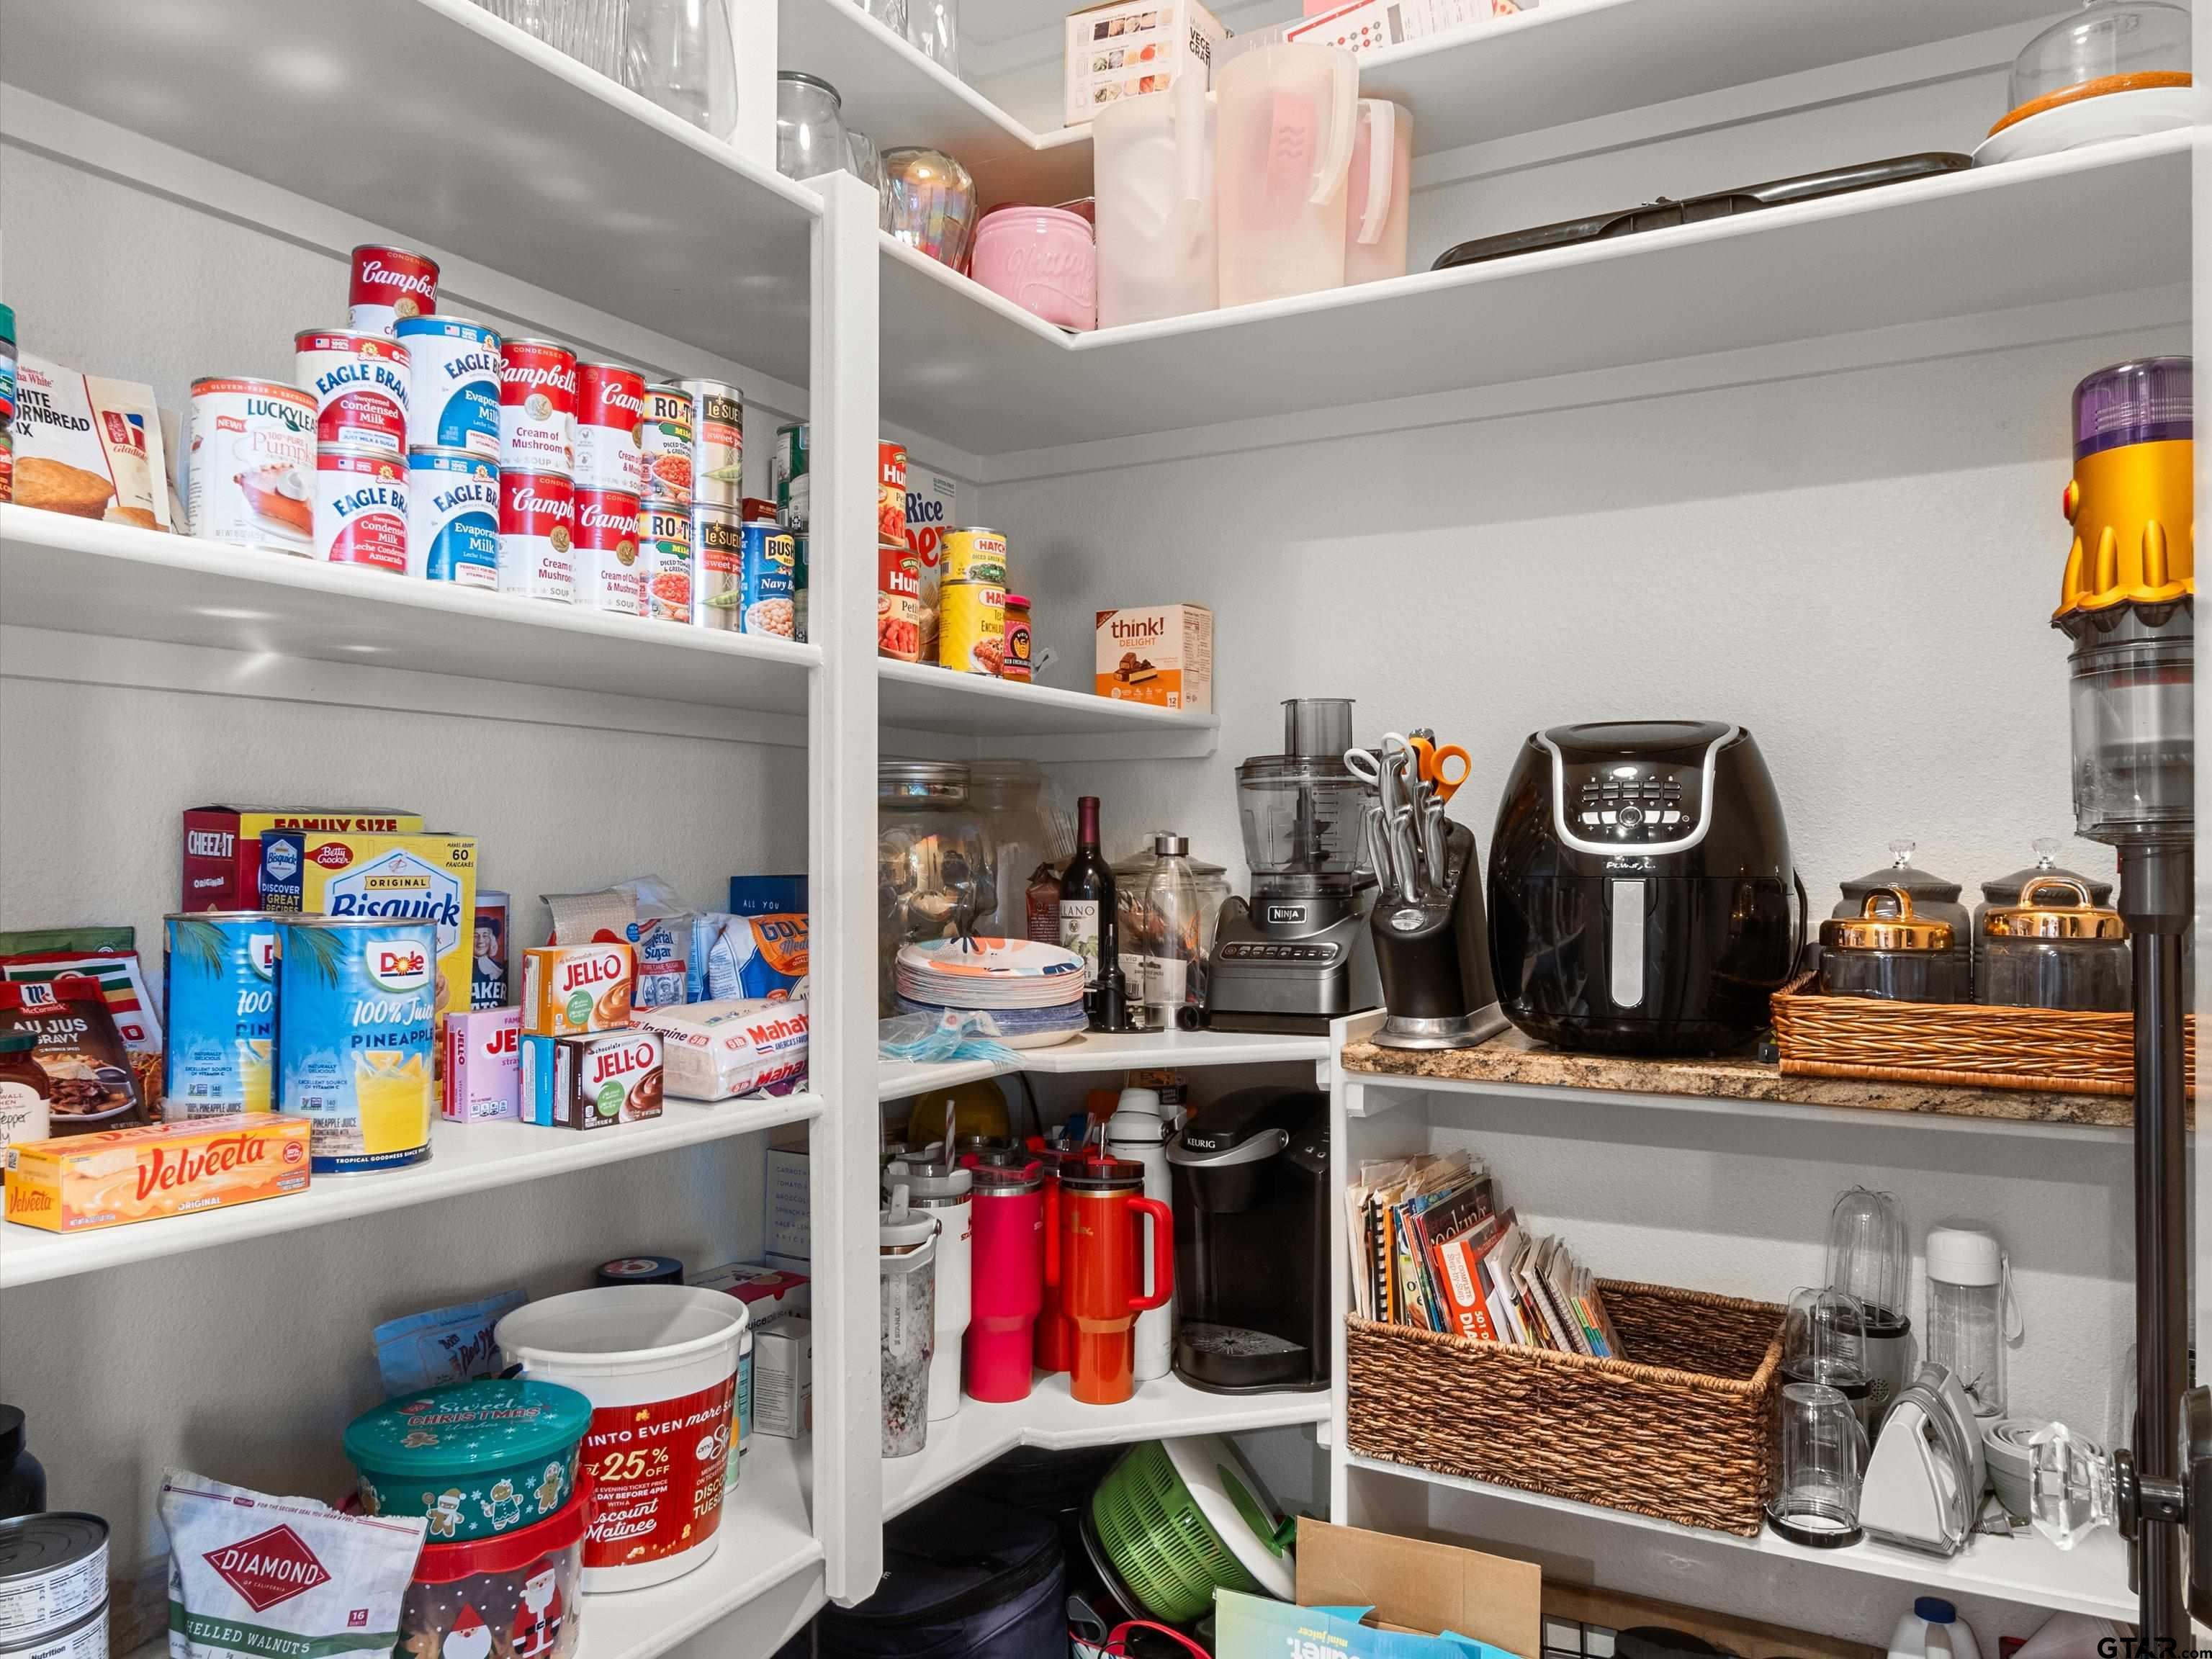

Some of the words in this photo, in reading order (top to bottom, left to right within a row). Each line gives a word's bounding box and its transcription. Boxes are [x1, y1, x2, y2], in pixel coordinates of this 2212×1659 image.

[444, 354, 490, 379] EAGLE
[30, 374, 52, 388] White
[315, 364, 369, 395] EAGLE
[340, 400, 399, 419] Condensed
[217, 418, 243, 431] NEW!
[360, 413, 385, 426] Milk
[287, 435, 305, 446] PURE
[516, 427, 549, 439] Cream
[550, 431, 559, 441] of
[707, 431, 733, 444] sweet
[512, 439, 562, 454] Mushroom
[333, 487, 387, 518] EAGLE
[433, 485, 482, 513] EAGLE
[906, 493, 943, 524] Rice
[378, 533, 399, 545] Milk
[469, 538, 495, 554] Milk
[542, 557, 568, 570] Cream
[704, 559, 732, 570] sweet
[601, 570, 621, 581] Cream
[760, 579, 786, 591] Navy
[1111, 617, 1164, 639] think!
[1119, 638, 1156, 647] DELIGHT
[321, 846, 346, 858] Betty
[452, 849, 469, 860] 60
[268, 853, 297, 866] Bisquick
[317, 854, 351, 864] Crocker
[262, 884, 300, 894] DISCOVER
[370, 878, 426, 887] ORIGINAL
[267, 894, 300, 906] GREAT
[742, 900, 756, 909] ALL
[331, 891, 461, 927] Bisquick
[1273, 907, 1300, 920] NINJA
[644, 946, 671, 961] Sugar
[380, 950, 425, 973] Dole
[21, 1002, 66, 1015] McCormick
[353, 999, 403, 1028] 100%
[47, 1018, 89, 1034] JUS
[351, 1027, 433, 1049] PINEAPPLE
[595, 1042, 621, 1054] chocolate
[313, 1118, 341, 1128] PINEAPPLE
[1187, 1136, 1217, 1150] KEURIG
[370, 1152, 403, 1162] GOODNESS
[136, 1133, 267, 1202] Velveeta
[777, 1180, 803, 1190] TOMATO
[9, 1187, 53, 1214] Velveeta
[178, 1196, 222, 1211] ORIGINAL
[1475, 1310, 1487, 1329] 501
[439, 1398, 515, 1413] Sweet
[408, 1406, 541, 1426] CHRISTMAS
[588, 1430, 632, 1447] INTO
[638, 1419, 683, 1439] EVEN
[685, 1405, 723, 1427] more
[645, 1465, 670, 1477] OFF
[650, 1479, 669, 1488] PRICE
[616, 1488, 649, 1499] BEFORE
[649, 1485, 669, 1495] 4PM
[279, 1505, 299, 1514] SECURE
[585, 1518, 657, 1543] Matinee
[221, 1549, 320, 1586] DIAMOND
[252, 1583, 286, 1593] CALIFORNIA
[351, 1611, 365, 1620] 16
[247, 1632, 310, 1655] WALNUTS
